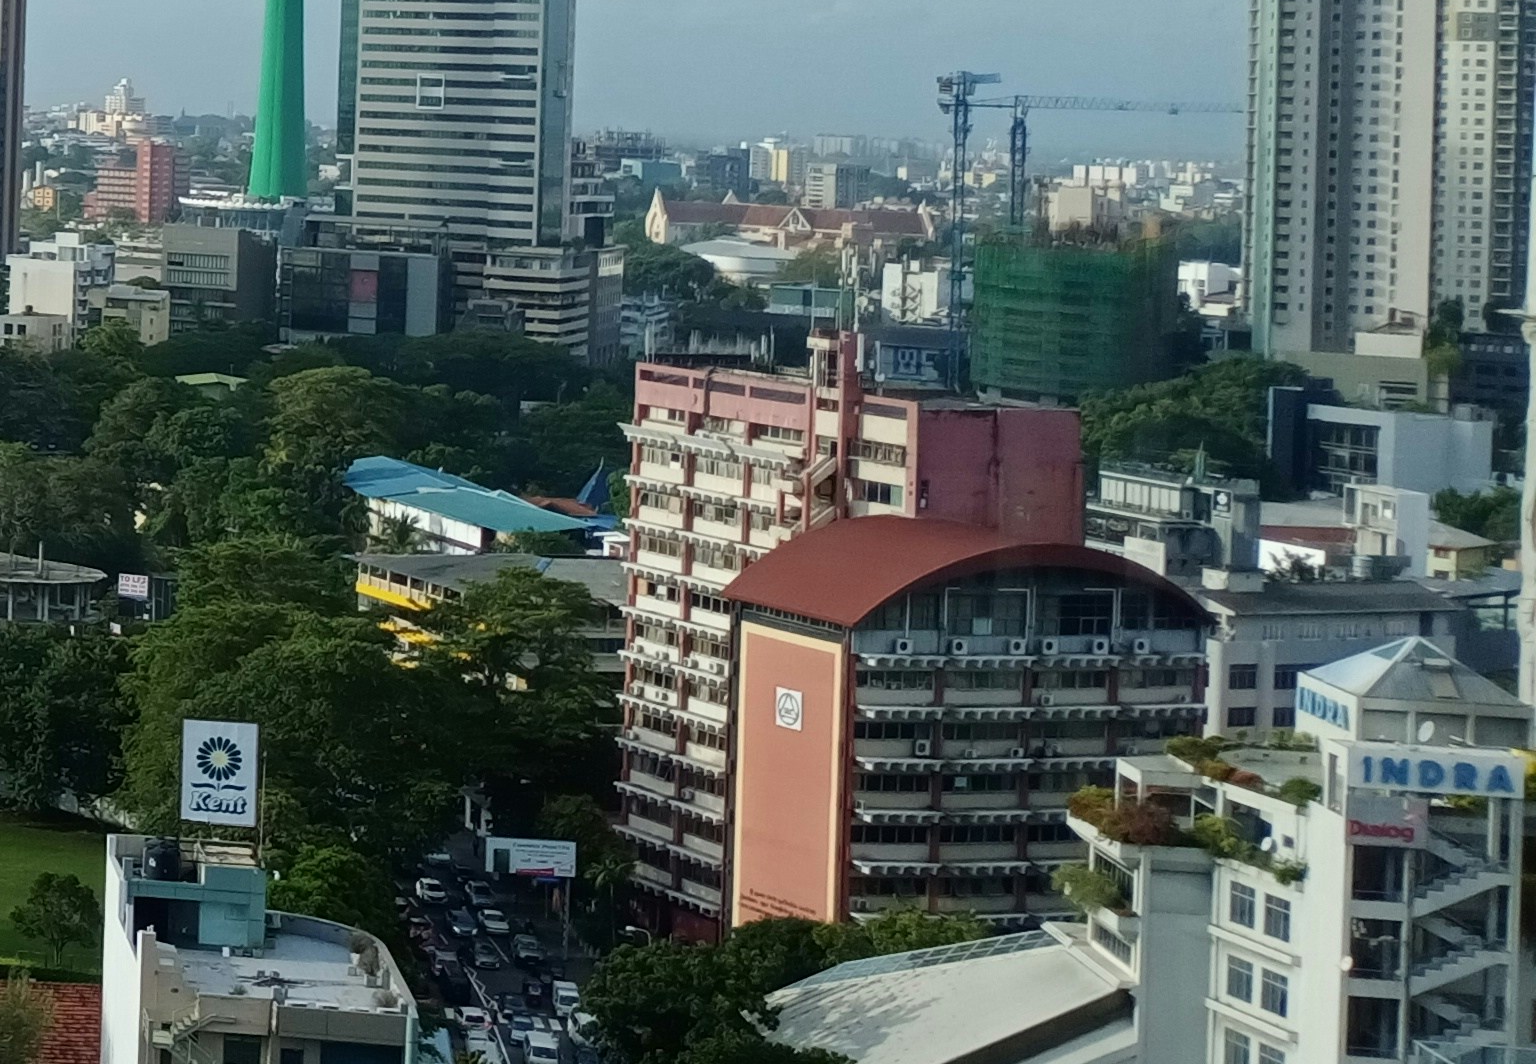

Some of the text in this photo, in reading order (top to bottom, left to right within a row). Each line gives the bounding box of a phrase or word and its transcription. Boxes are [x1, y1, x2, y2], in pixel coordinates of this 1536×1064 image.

[1298, 686, 1350, 732] INDRA
[1362, 755, 1515, 793] INDRA
[189, 790, 247, 814] Kent
[1348, 820, 1415, 843] Dialog
